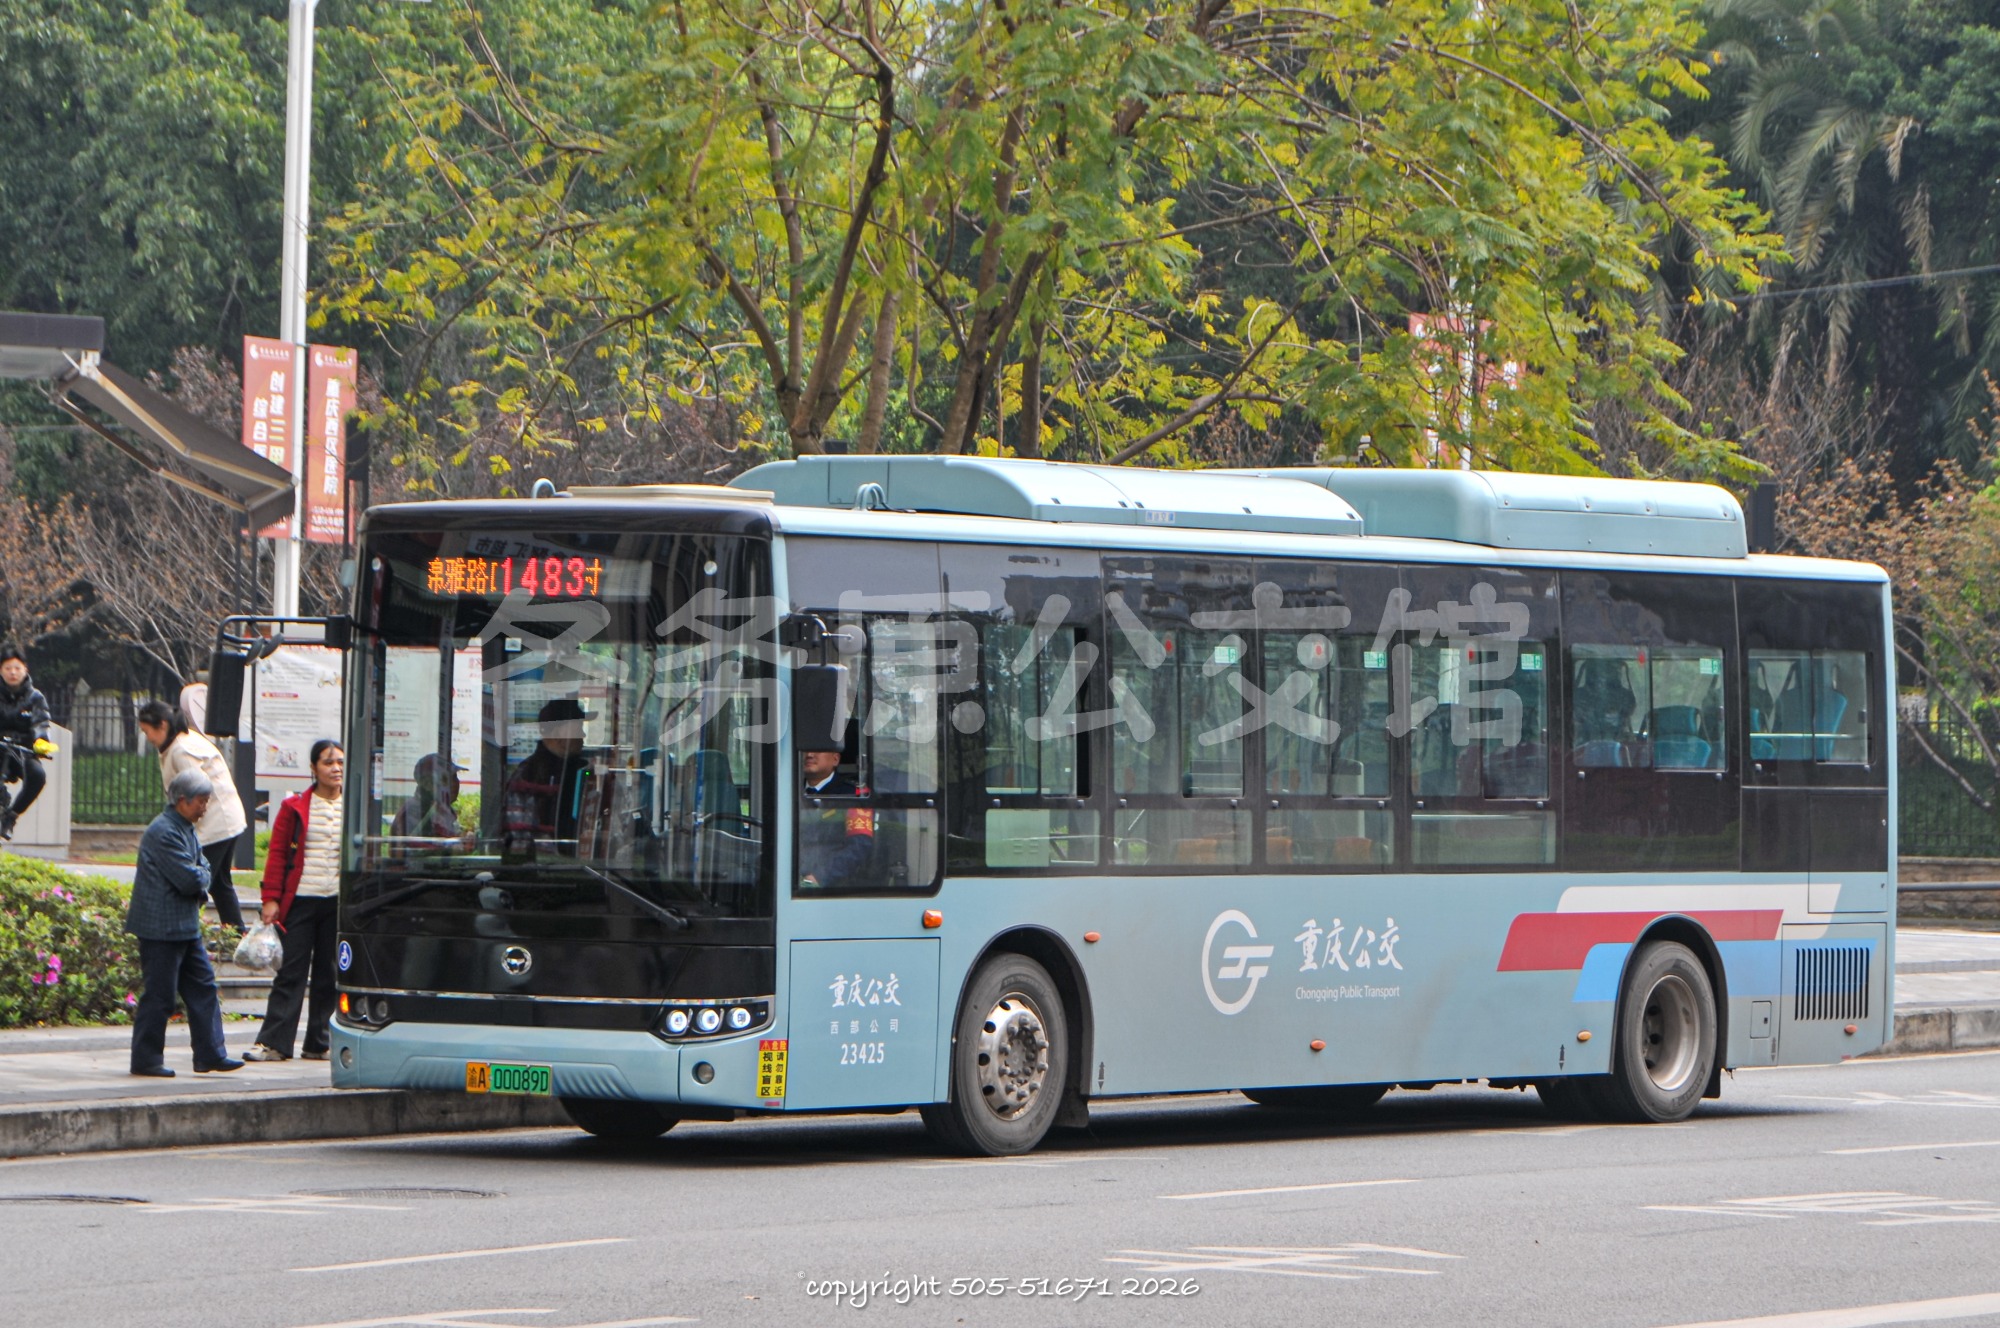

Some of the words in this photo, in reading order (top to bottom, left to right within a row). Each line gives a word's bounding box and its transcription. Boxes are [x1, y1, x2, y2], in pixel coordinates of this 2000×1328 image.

[501, 557, 586, 596] 1483
[1294, 917, 1403, 972] 重庆公交
[828, 973, 902, 1008] 重庆公交
[1295, 986, 1339, 1002] Chongqing
[1340, 985, 1363, 998] Public
[1364, 985, 1400, 999] Transport
[830, 1018, 899, 1035] 西部公司
[840, 1042, 885, 1065] 23425
[761, 1052, 773, 1096] 视线盲区
[774, 1052, 785, 1096] 请勿靠近
